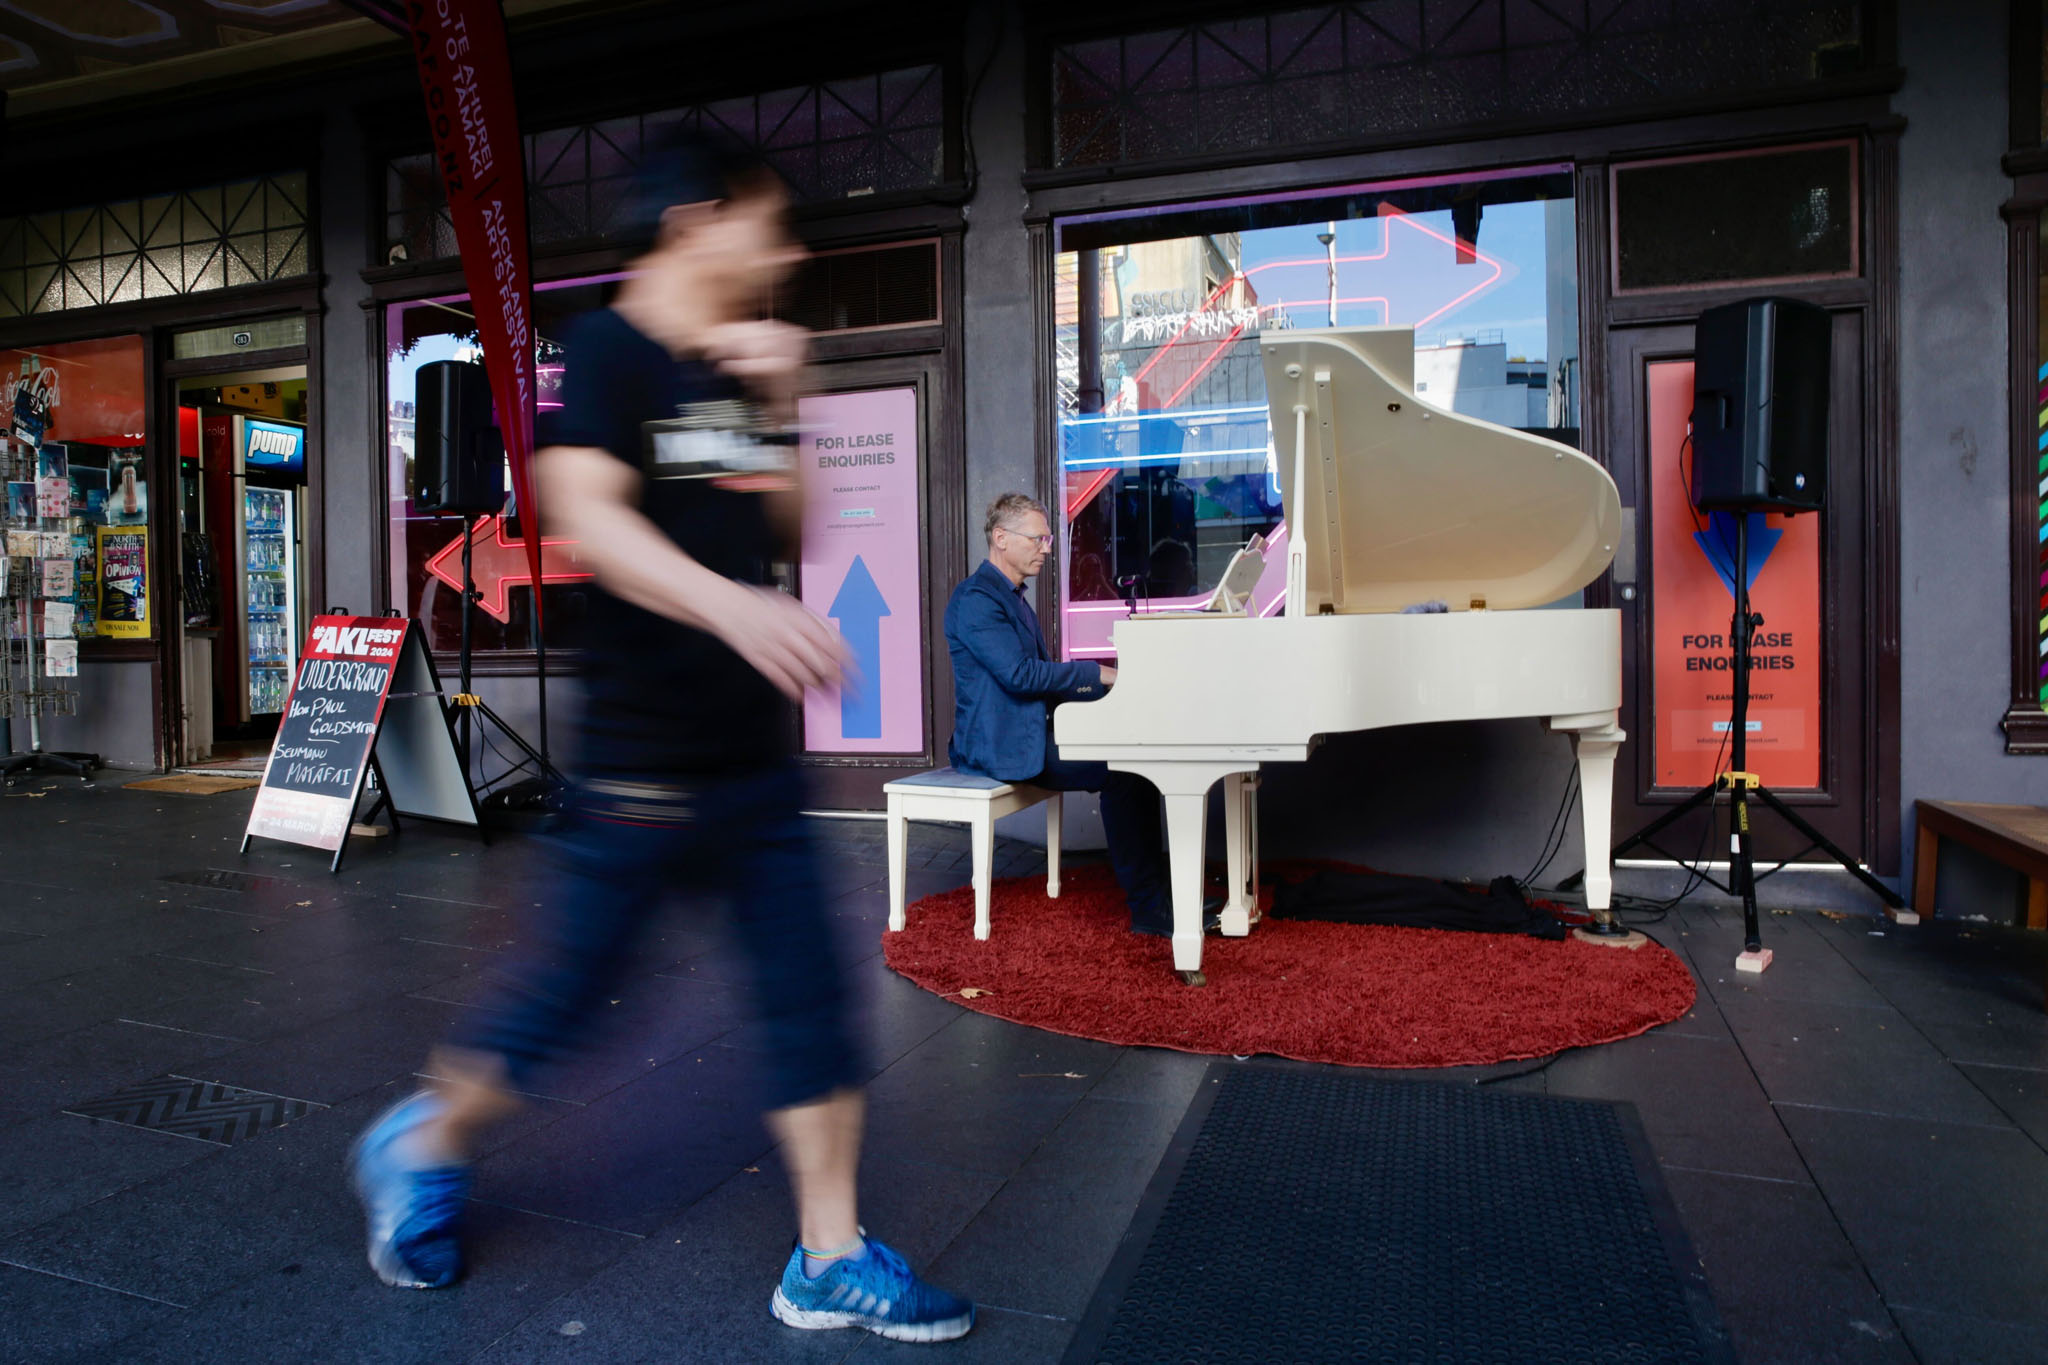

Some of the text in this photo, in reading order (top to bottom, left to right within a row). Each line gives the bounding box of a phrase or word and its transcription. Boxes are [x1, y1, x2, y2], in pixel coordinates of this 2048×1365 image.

[436, 0, 452, 28] OI
[446, 37, 458, 62] O
[454, 12, 494, 171] TE AHUREI
[491, 199, 528, 347] AUCKLAND
[481, 208, 529, 412] ARTS FESTIVAL
[247, 428, 298, 463] pump
[816, 433, 894, 451] FOR LEASE
[818, 452, 896, 469] ENQUIRIES
[1682, 632, 1793, 649] FOR LASE
[369, 647, 394, 658] 2024
[1686, 655, 1795, 672] ENQRIES
[310, 697, 347, 718] PAUL
